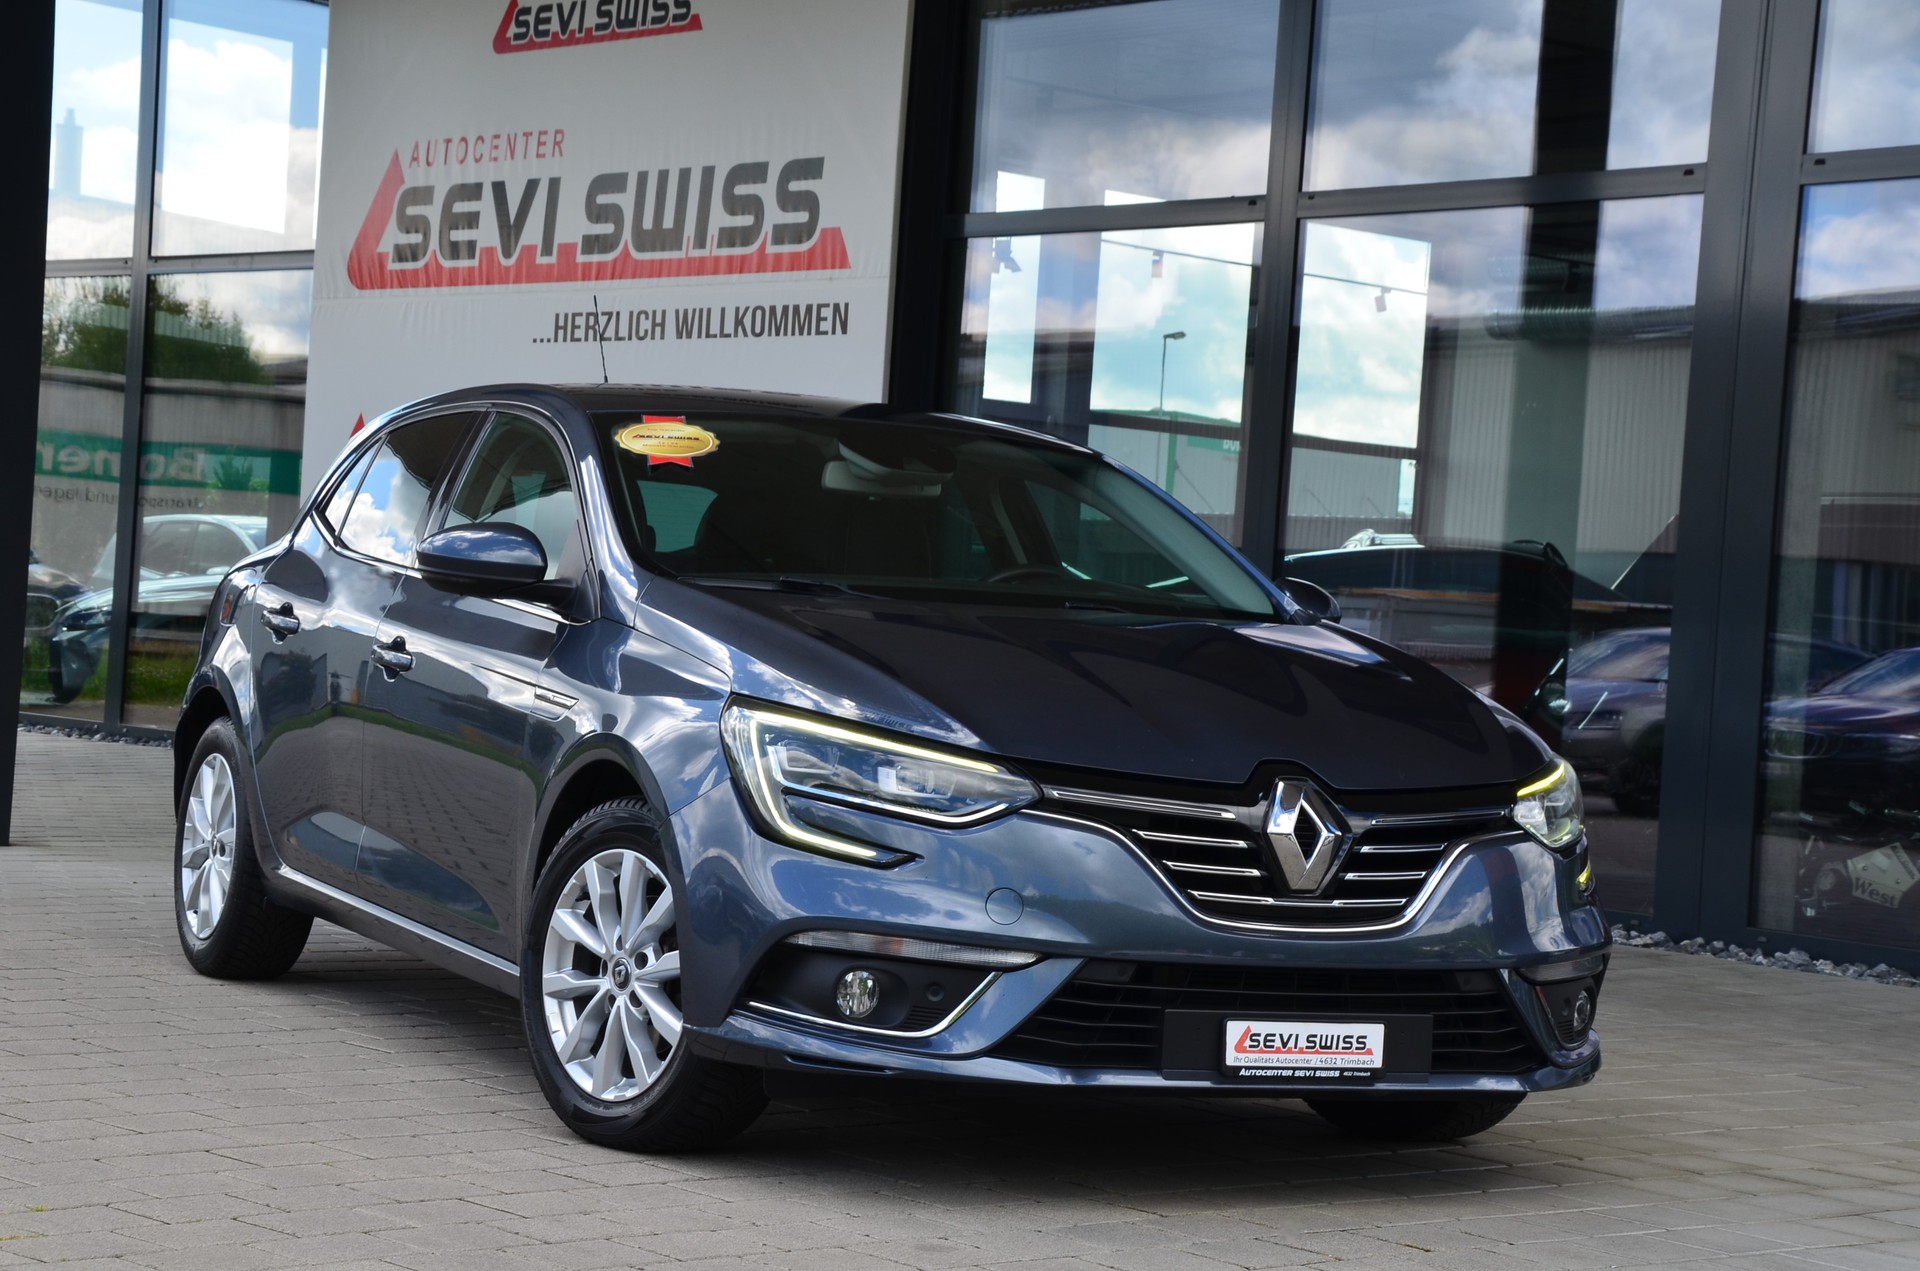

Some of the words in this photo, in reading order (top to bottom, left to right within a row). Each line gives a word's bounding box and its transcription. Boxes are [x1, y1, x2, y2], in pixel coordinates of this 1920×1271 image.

[512, 0, 588, 42] SEVI
[594, 0, 692, 32] SWISS
[408, 128, 566, 169] AUTOCENTER
[391, 176, 562, 264] SEVI
[577, 156, 826, 256] SWISS
[532, 309, 667, 344] ...HERZLICH
[674, 302, 850, 340] WILLKOMMEN
[1854, 876, 1898, 907] West
[1248, 1032, 1299, 1050] SEVI
[1304, 1033, 1368, 1051] SWISS
[1233, 1056, 1243, 1064] Ihr
[1275, 1056, 1313, 1065] Autocenter
[1319, 1057, 1338, 1065] 4632
[1340, 1057, 1375, 1066] Trimbach
[1294, 1069, 1314, 1077] SEVI
[1314, 1070, 1341, 1078] SWISS
